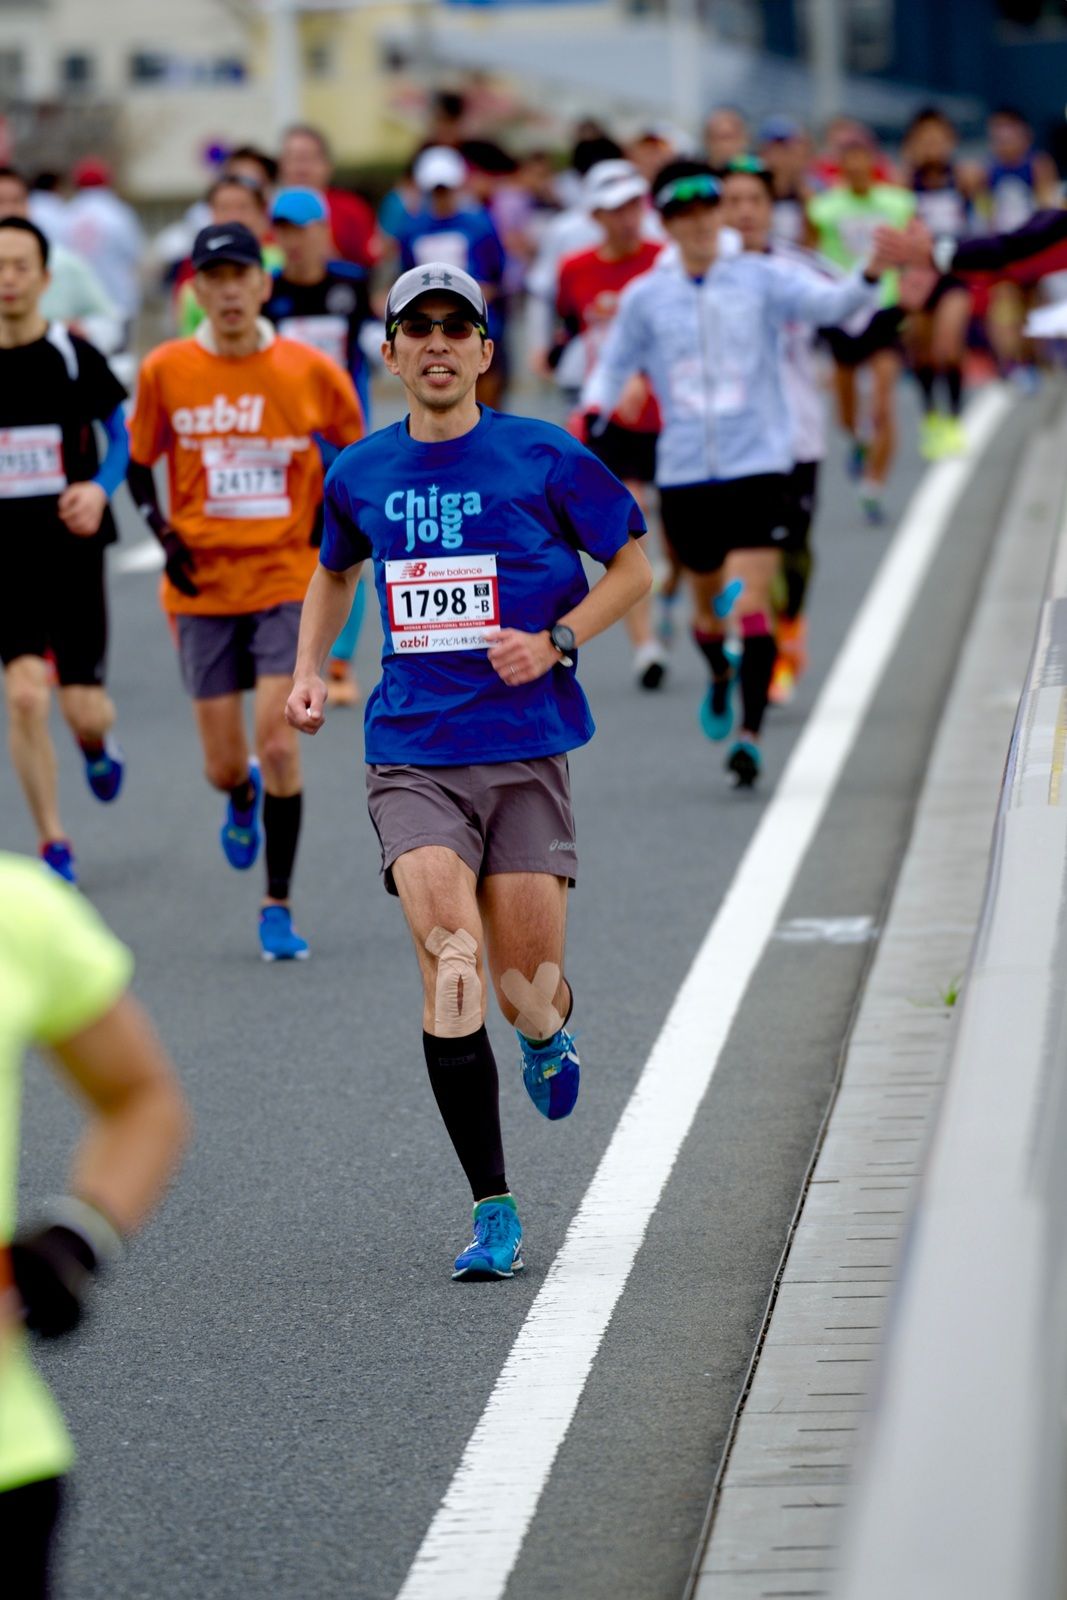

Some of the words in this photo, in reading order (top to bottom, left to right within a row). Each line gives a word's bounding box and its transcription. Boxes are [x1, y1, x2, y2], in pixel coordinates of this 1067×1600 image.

[172, 394, 264, 435] azbil
[216, 469, 267, 495] 2417
[384, 483, 483, 523] Chiga
[428, 569, 445, 577] new
[446, 567, 482, 576] balance
[400, 587, 467, 618] 1798
[400, 635, 429, 649] azbil
